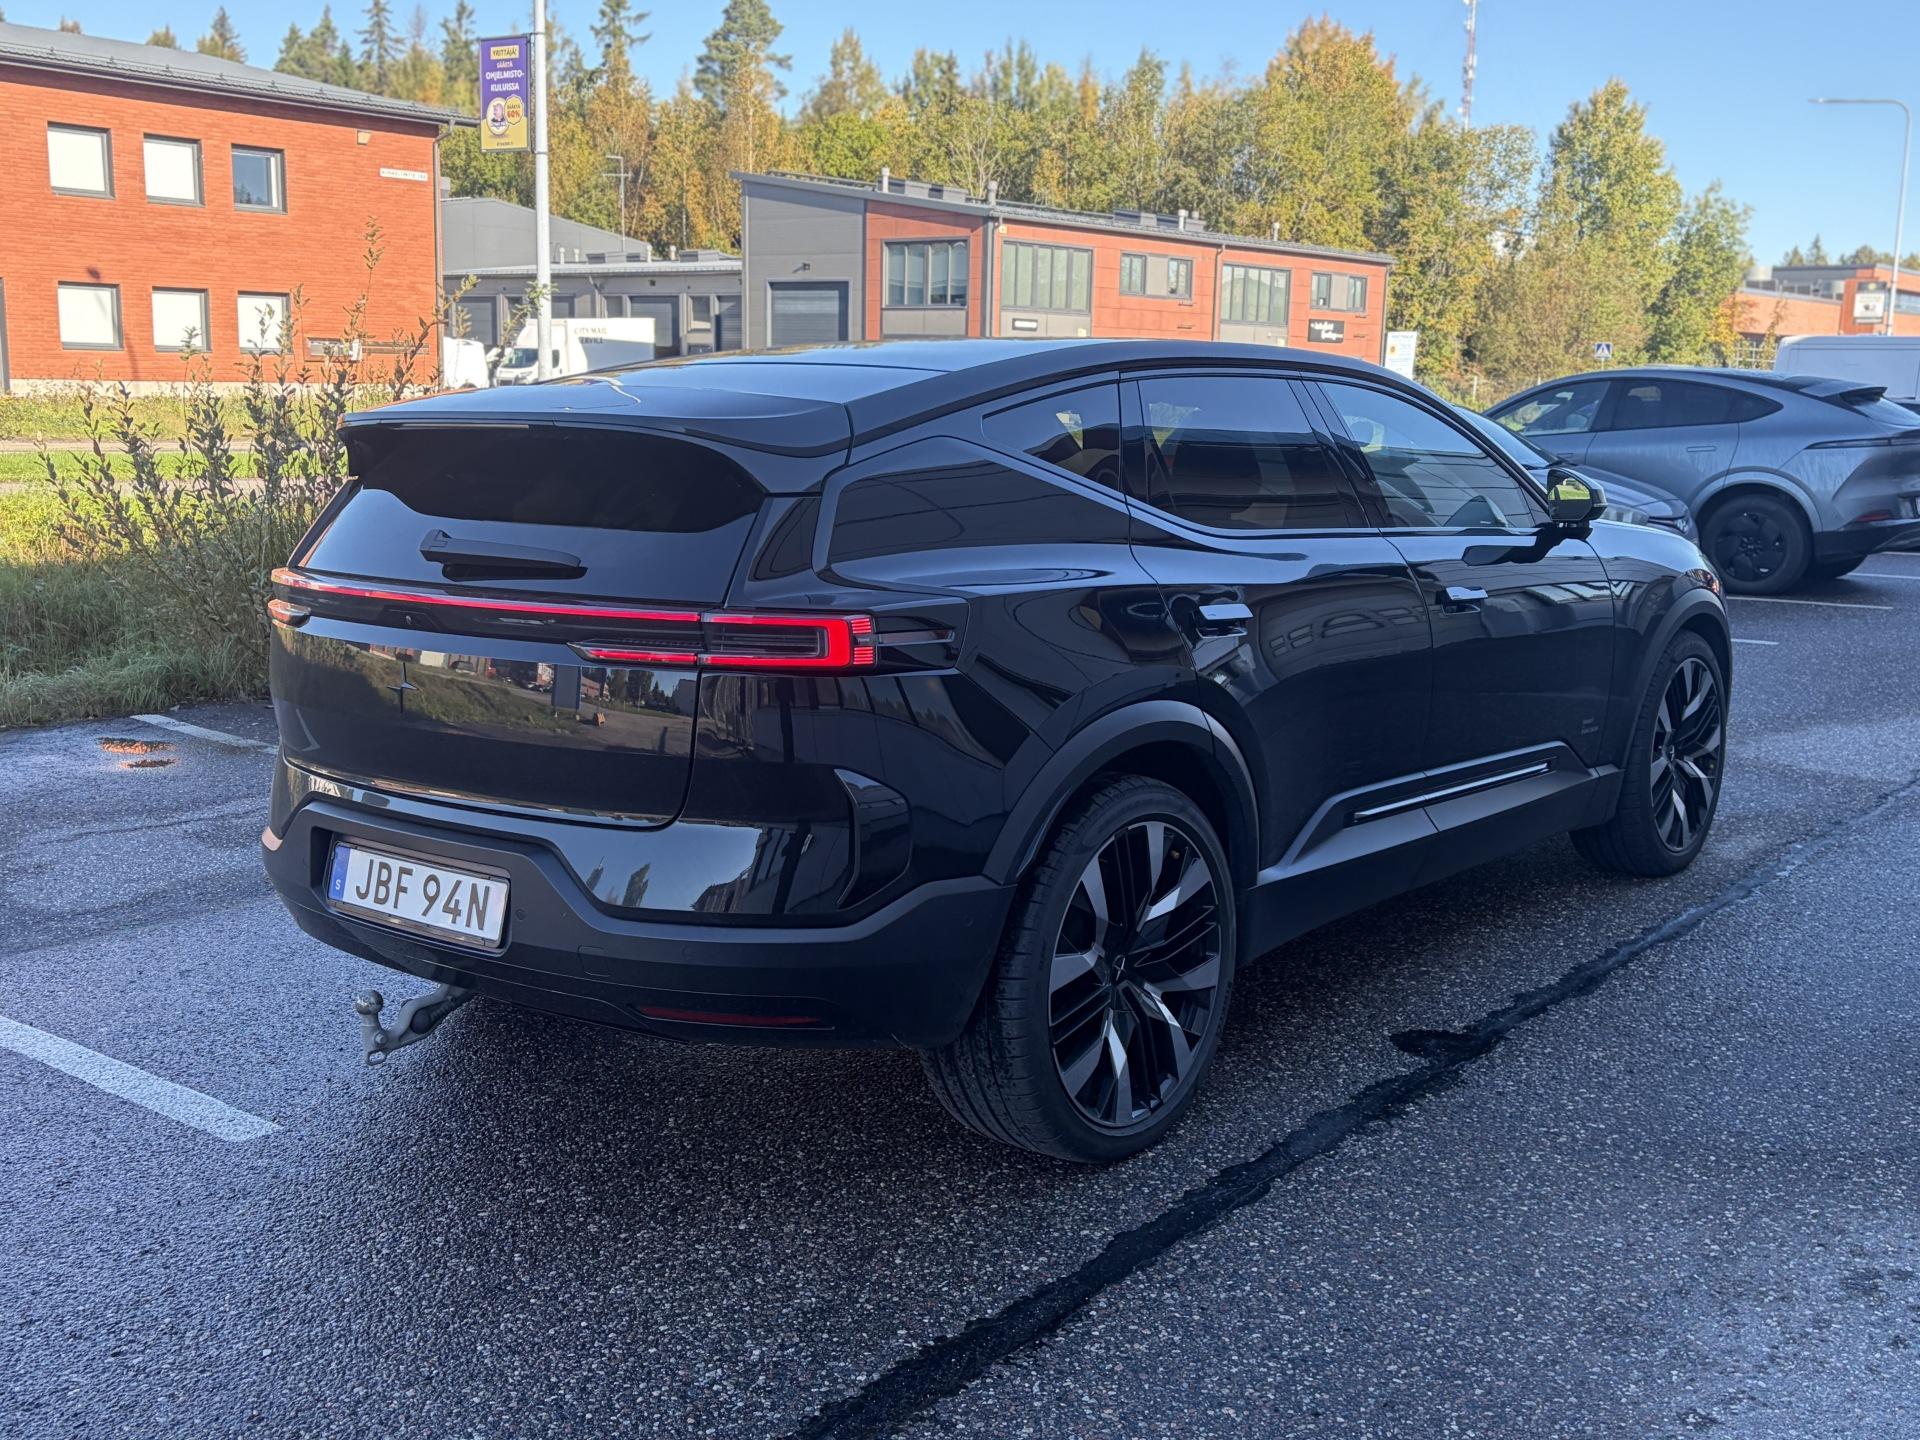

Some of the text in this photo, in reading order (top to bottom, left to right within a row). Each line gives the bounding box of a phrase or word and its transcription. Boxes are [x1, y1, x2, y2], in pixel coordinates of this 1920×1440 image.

[485, 70, 525, 81] OHJELMISTO-
[490, 82, 520, 92] KULUISSA
[335, 879, 341, 891] S
[355, 858, 490, 931] JBF 94N
